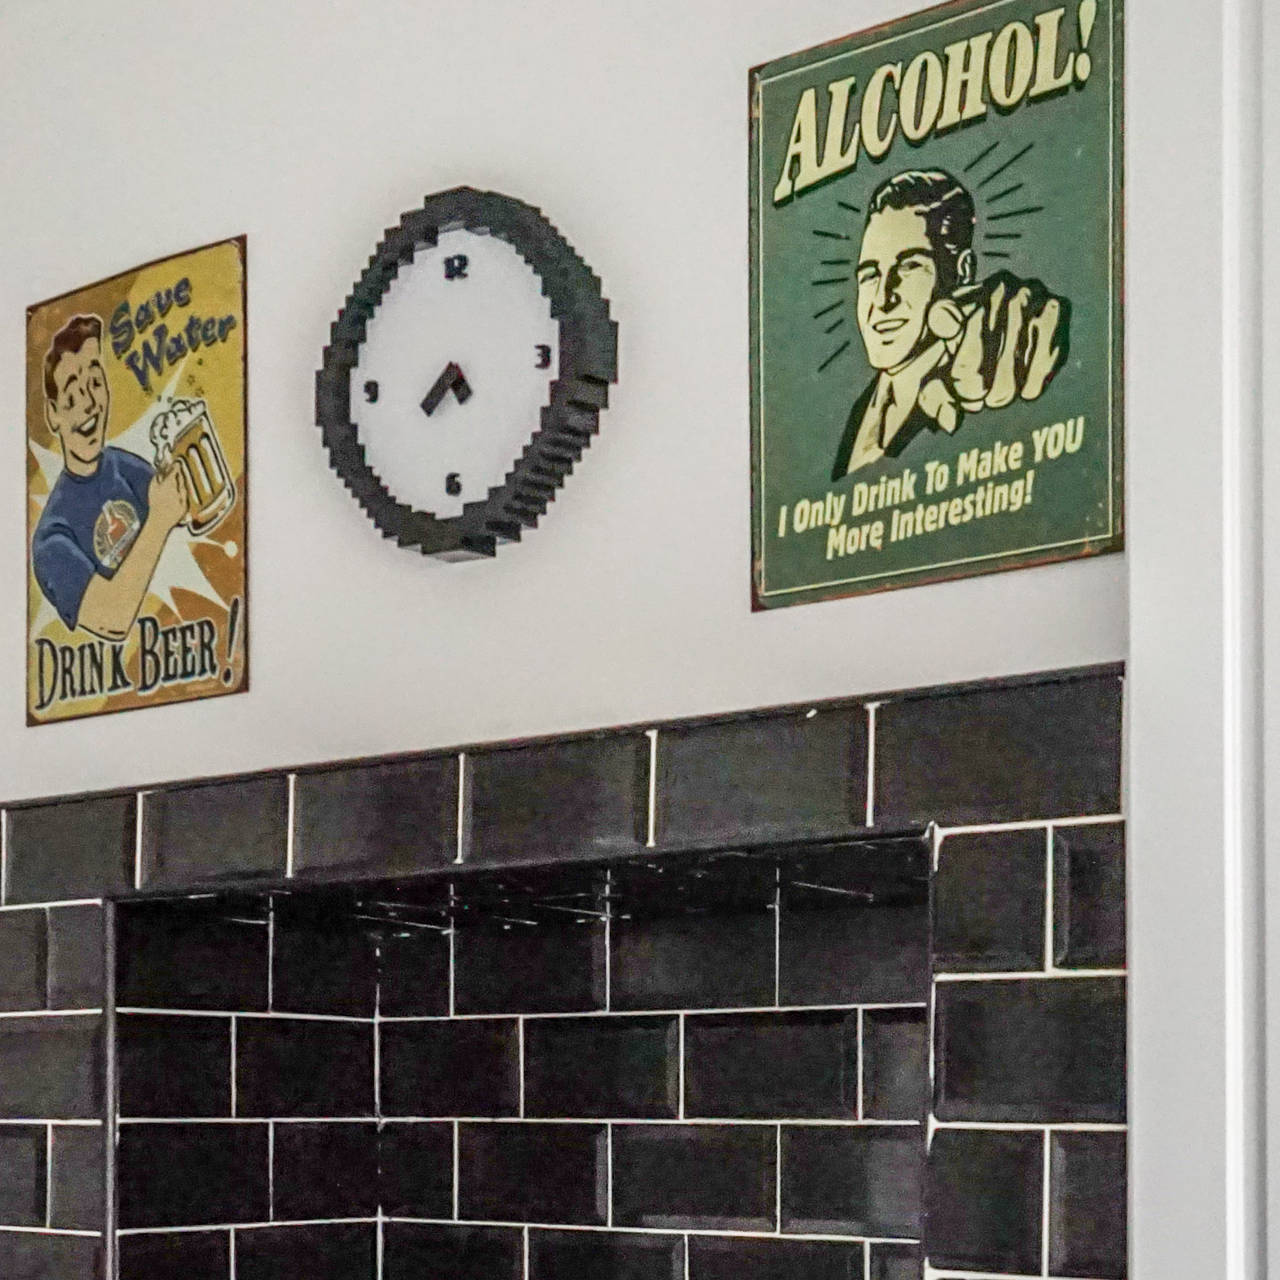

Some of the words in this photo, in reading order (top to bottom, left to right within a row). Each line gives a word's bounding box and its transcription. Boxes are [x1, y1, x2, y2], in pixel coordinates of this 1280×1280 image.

[773, 0, 1098, 203] ALCOHOL!
[109, 276, 194, 360] Save
[125, 314, 237, 393] Water
[533, 343, 552, 370] 3
[444, 472, 463, 497] 6
[777, 504, 788, 538] I
[792, 491, 846, 534] Only
[851, 468, 918, 517] Drink
[924, 460, 949, 495] To
[956, 439, 1024, 486] Make
[1031, 415, 1085, 463] YOU
[826, 525, 885, 561] More
[890, 469, 1036, 542] Interesting!
[34, 637, 132, 711] DRINK
[136, 597, 240, 692] BEER!
